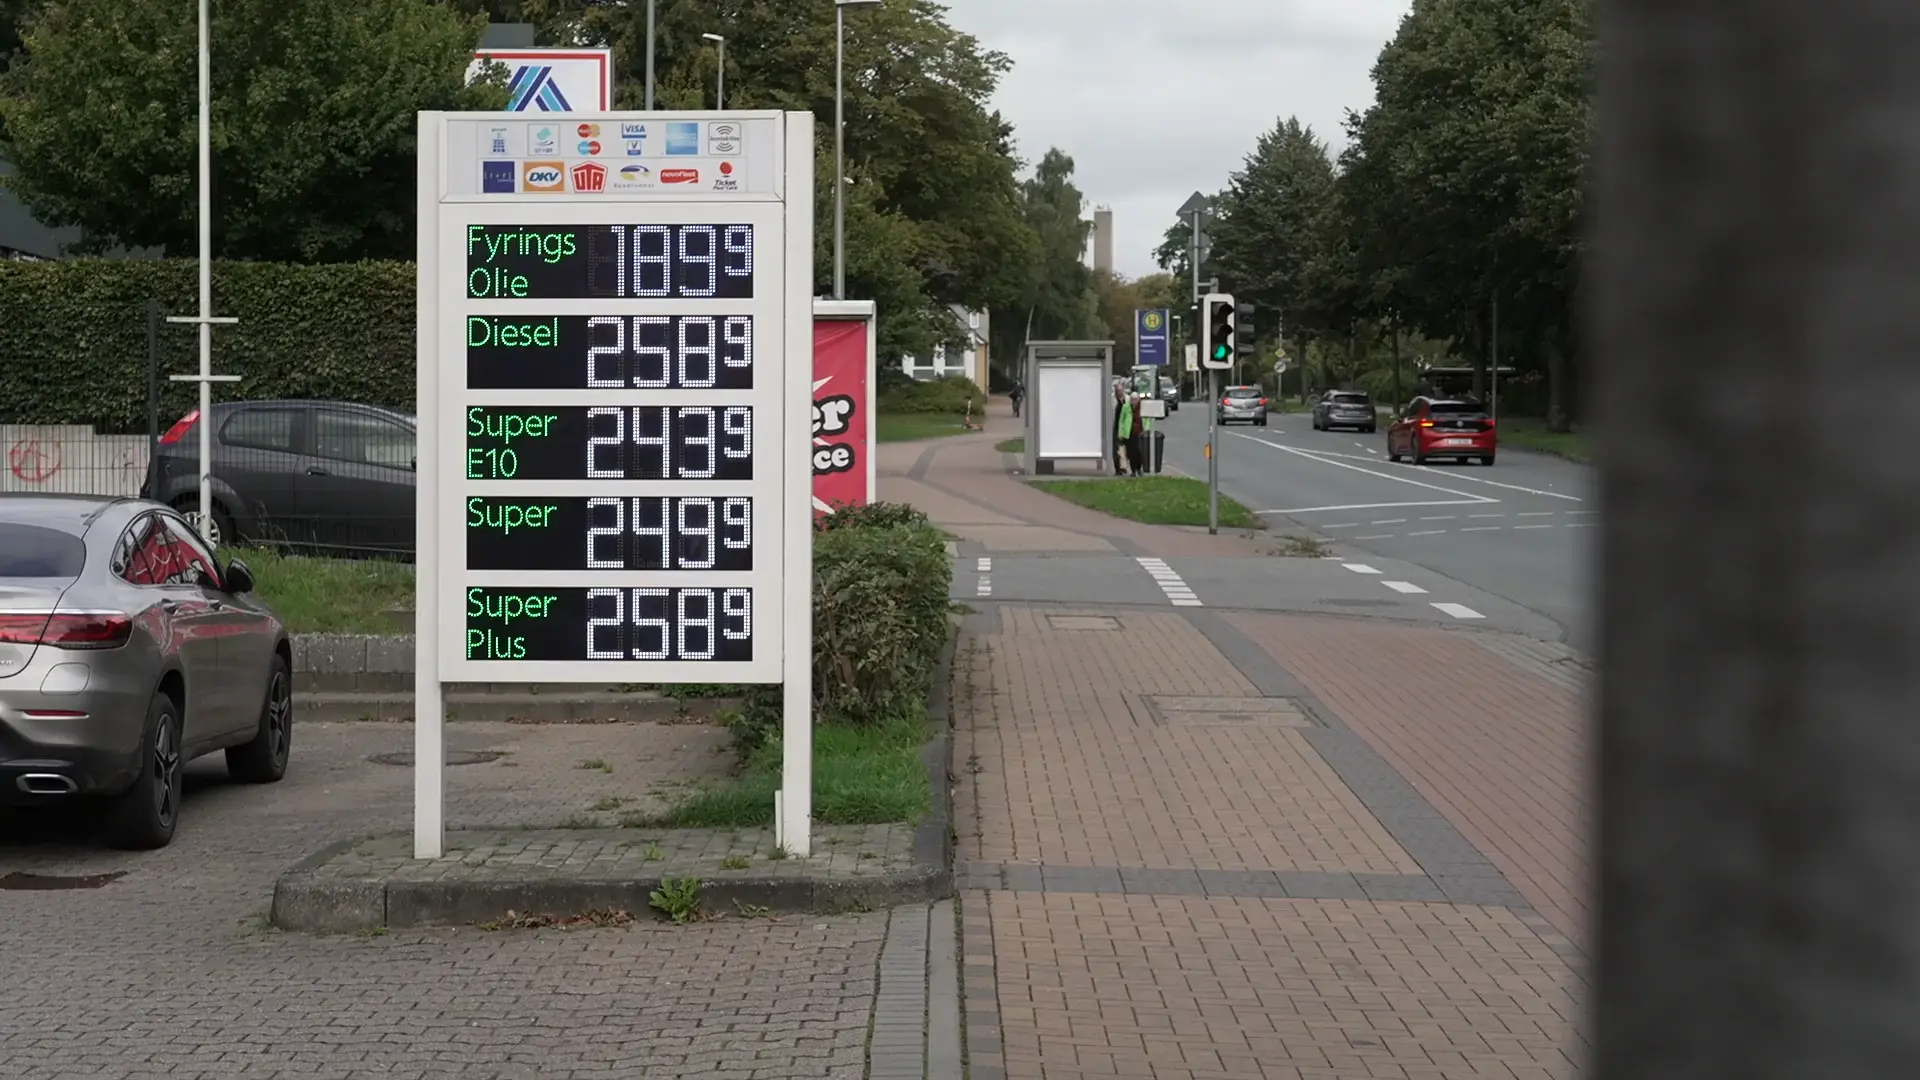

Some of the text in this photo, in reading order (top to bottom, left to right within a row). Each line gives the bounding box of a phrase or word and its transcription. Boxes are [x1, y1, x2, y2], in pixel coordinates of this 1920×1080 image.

[625, 124, 646, 133] VISA
[529, 172, 559, 182] DKV
[573, 164, 606, 191] UTA
[468, 226, 577, 263] Fyrings
[468, 267, 529, 297] Olie
[468, 317, 558, 347] Diesel
[468, 408, 558, 444] Super
[468, 448, 518, 478] E10
[468, 499, 558, 534] Super
[467, 589, 558, 625] Super
[467, 629, 527, 659] Plus
